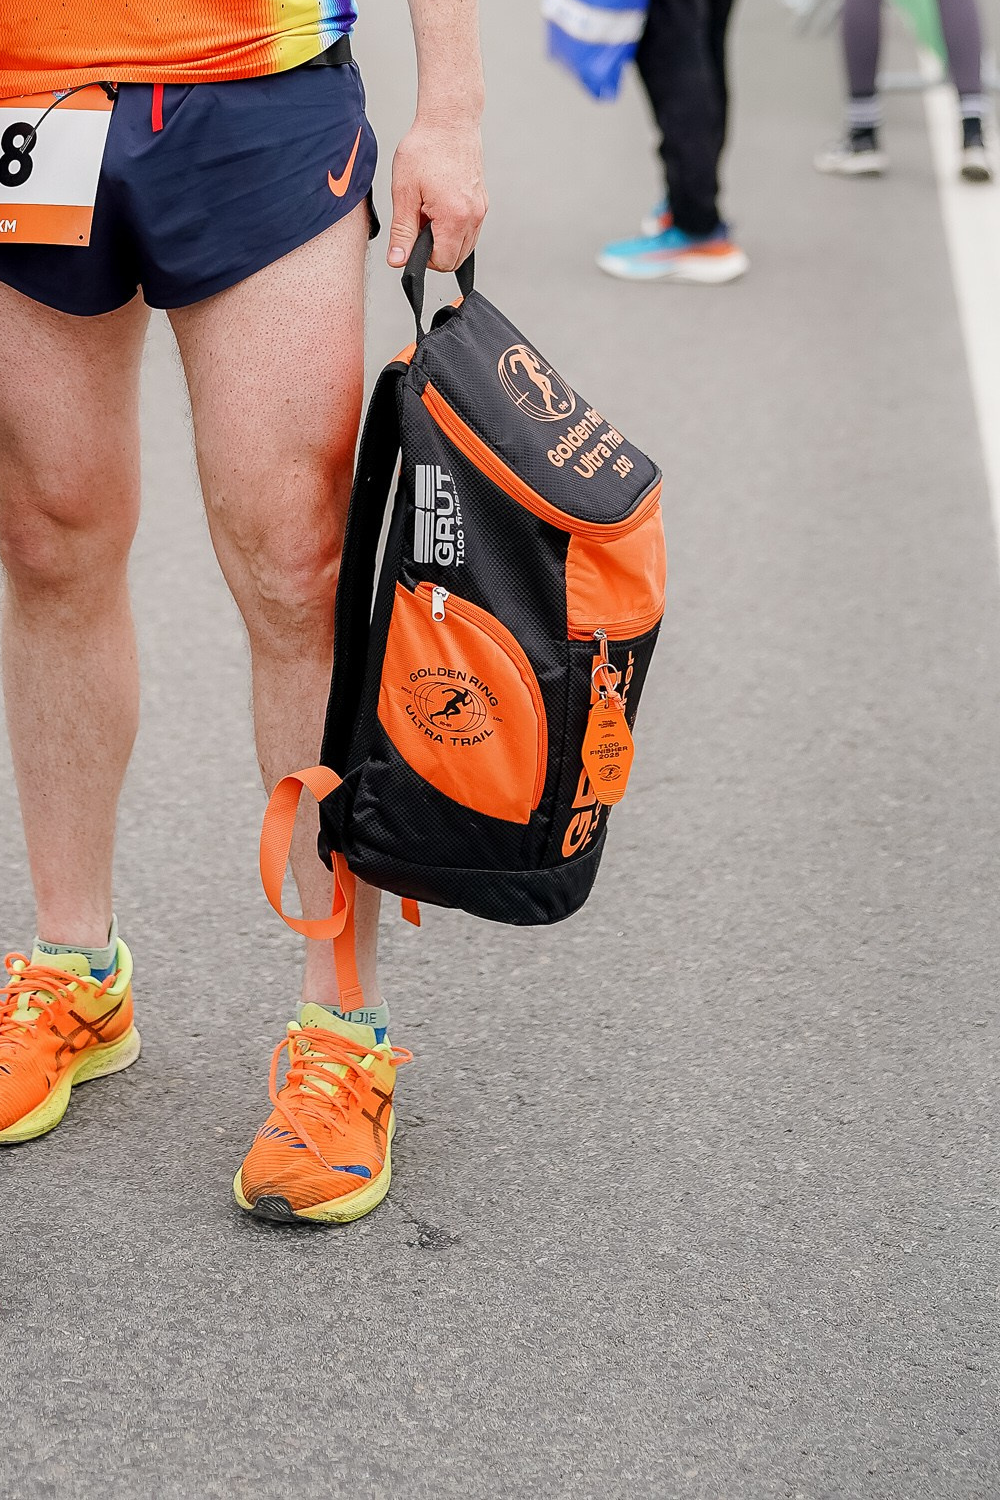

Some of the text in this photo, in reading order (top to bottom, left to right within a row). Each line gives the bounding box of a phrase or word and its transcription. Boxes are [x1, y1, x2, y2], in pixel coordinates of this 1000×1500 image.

[547, 407, 604, 468] Golden Rin
[573, 425, 625, 479] Ultra Trai
[612, 454, 634, 479] 100
[435, 465, 455, 566] GRUT
[448, 469, 465, 567] T100 finis
[409, 667, 498, 707] GOLDEN RING
[405, 704, 494, 746] ULTRA TRAIL
[589, 746, 628, 756] FINISHER
[599, 752, 620, 760] 2025
[332, 1010, 377, 1024] NIJIE
